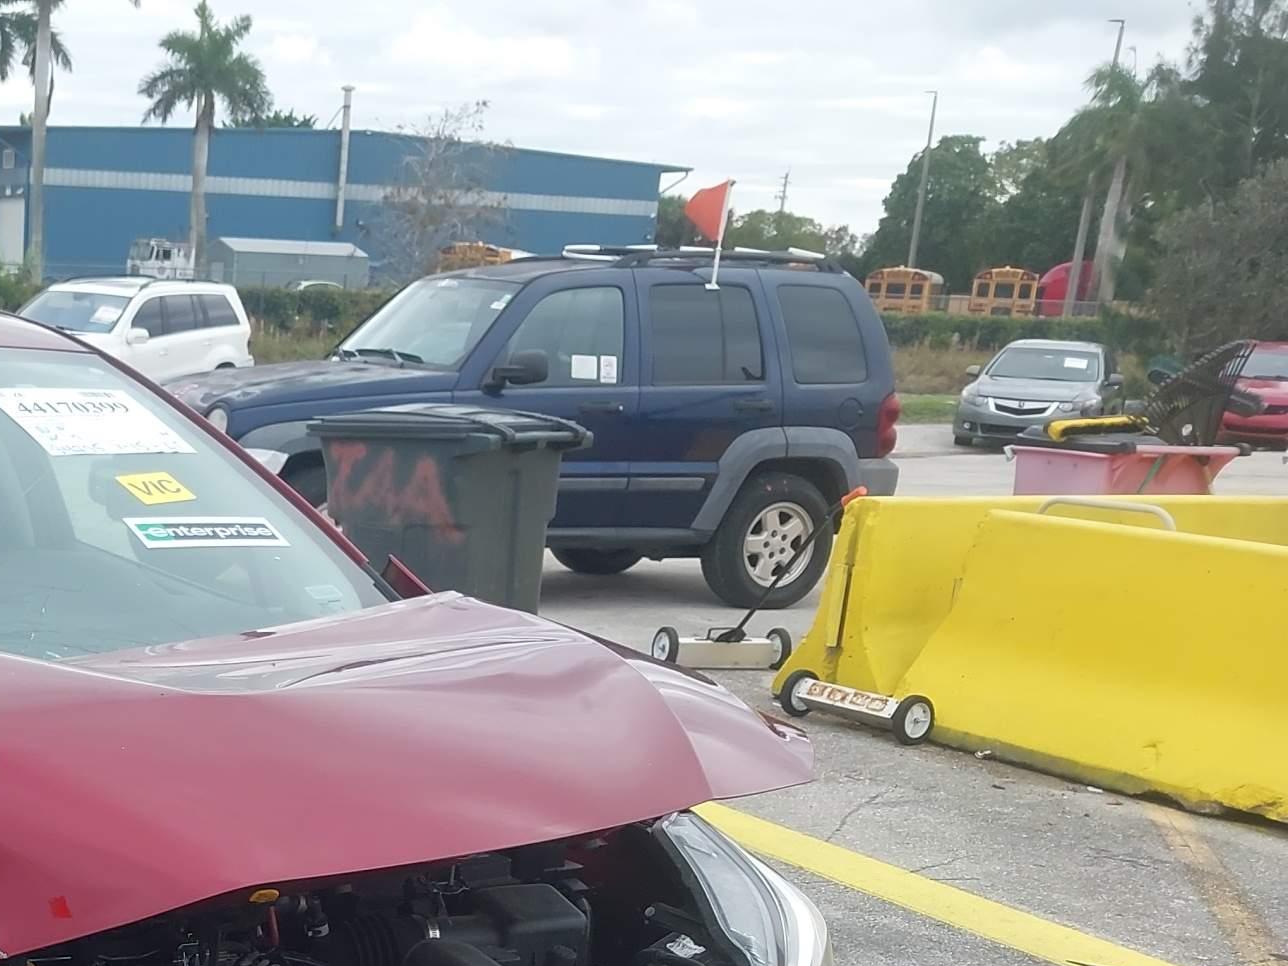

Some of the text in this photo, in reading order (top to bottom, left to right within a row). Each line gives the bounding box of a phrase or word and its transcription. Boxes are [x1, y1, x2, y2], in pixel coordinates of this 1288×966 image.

[17, 400, 130, 415] 44170399
[127, 478, 182, 497] VIC
[142, 524, 274, 539] enterprise
